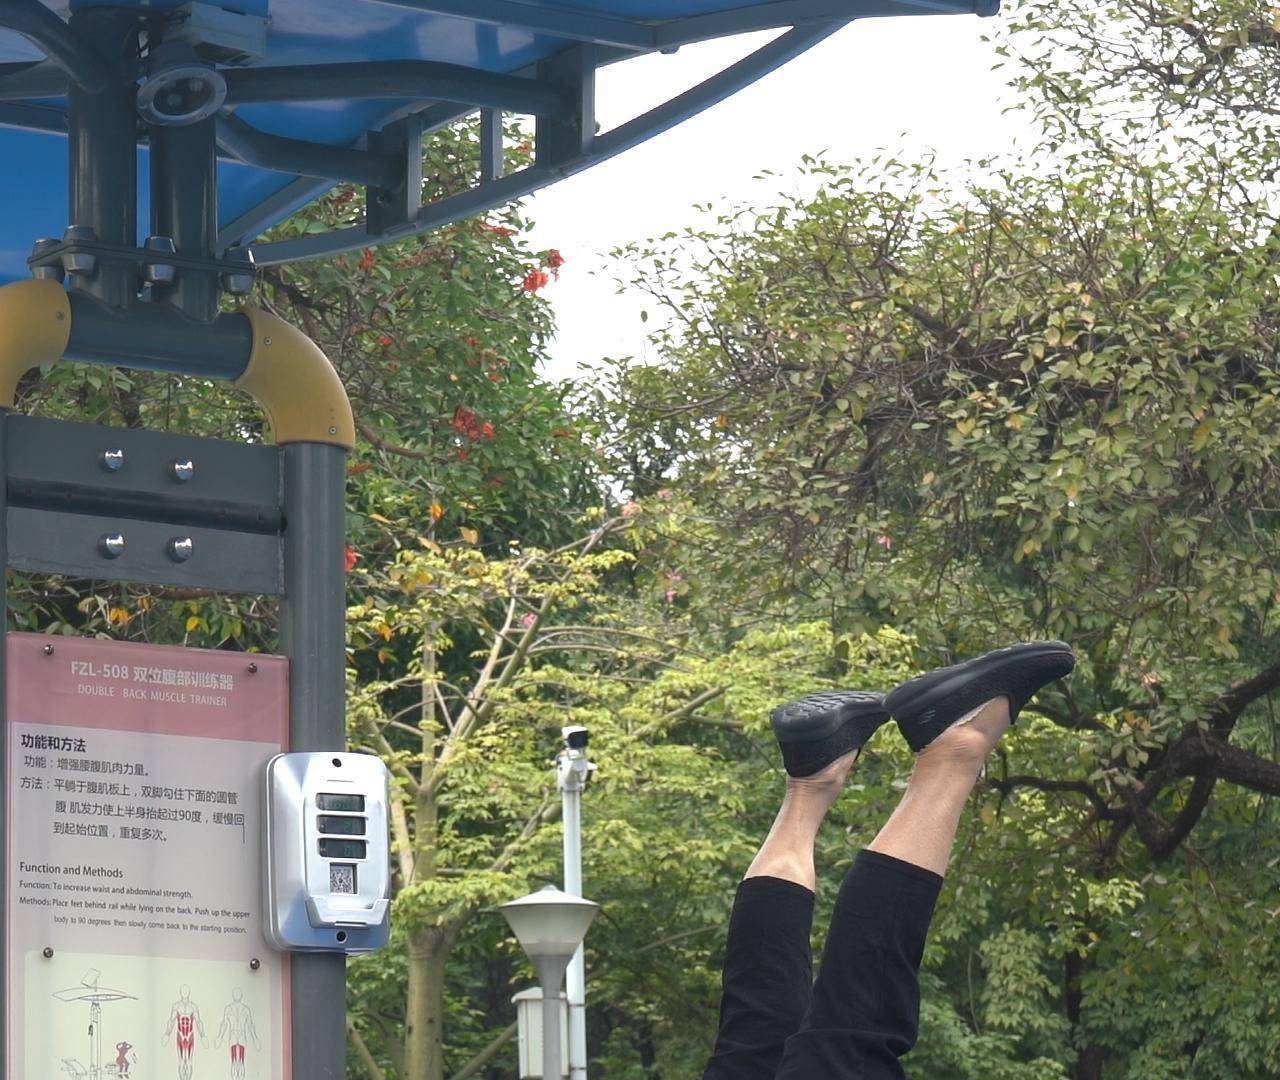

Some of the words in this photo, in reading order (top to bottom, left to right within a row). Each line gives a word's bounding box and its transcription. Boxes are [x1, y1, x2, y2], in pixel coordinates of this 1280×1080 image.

[71, 661, 129, 680] FZL-508
[78, 684, 115, 697] DOUBLE
[123, 688, 147, 700] BACK
[150, 690, 186, 704] MUSCLE
[190, 694, 227, 707] TRAINER
[20, 734, 86, 753] 功能和方法
[19, 861, 61, 874] Function
[63, 865, 81, 876] and
[82, 866, 124, 879] Methods
[19, 880, 51, 890] Function:
[53, 882, 62, 890] To
[63, 884, 91, 892] increase
[92, 885, 110, 894] waist
[111, 886, 125, 895] and
[126, 887, 162, 897] abdominal
[163, 889, 193, 900] strength.
